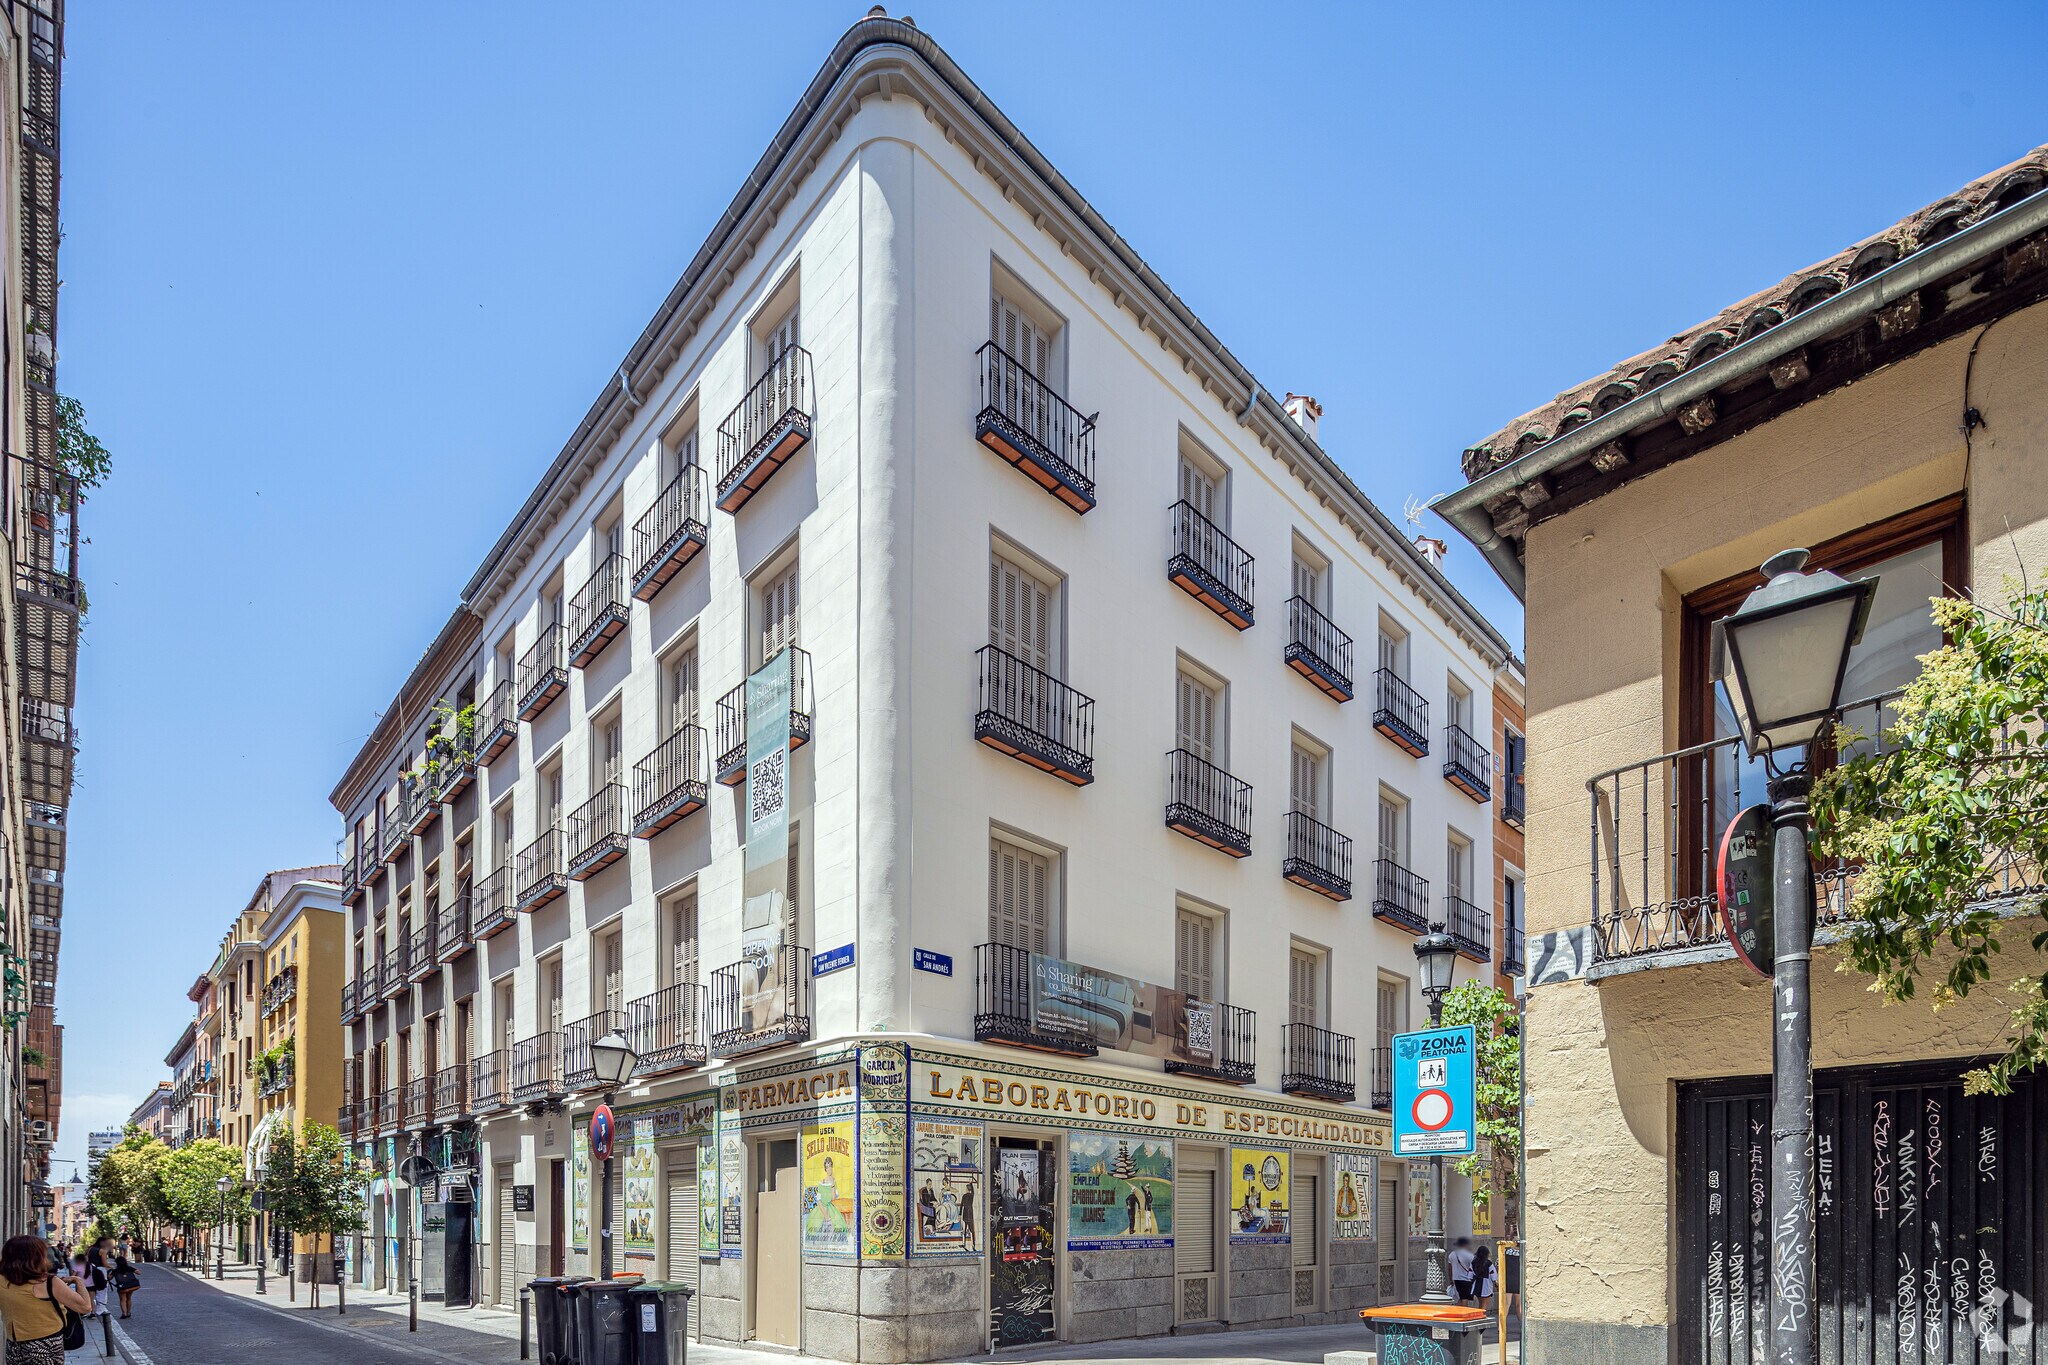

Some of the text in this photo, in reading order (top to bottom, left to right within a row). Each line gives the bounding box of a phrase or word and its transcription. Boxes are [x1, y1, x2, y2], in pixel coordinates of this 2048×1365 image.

[757, 669, 788, 694] Sharing
[753, 814, 783, 836] BOOK NOW
[745, 933, 781, 956] OPENING
[751, 952, 775, 971] SOON
[923, 960, 949, 974] SAN ANDRÉS
[1048, 966, 1093, 993] Sharing
[1048, 982, 1079, 998] co_living
[1421, 1034, 1467, 1051] ZONA
[1421, 1046, 1467, 1058] PEATONAL
[866, 1060, 896, 1072] GARCIA
[862, 1072, 903, 1086] RODRIGUEZ
[738, 1070, 853, 1112] FARMACIA
[930, 1071, 1384, 1146] LABORATORIO DE ESPECIALIDADES
[819, 1127, 835, 1135] USEN
[806, 1136, 850, 1160] SELLO JUANSE
[1081, 1207, 1106, 1223] JUANSE
